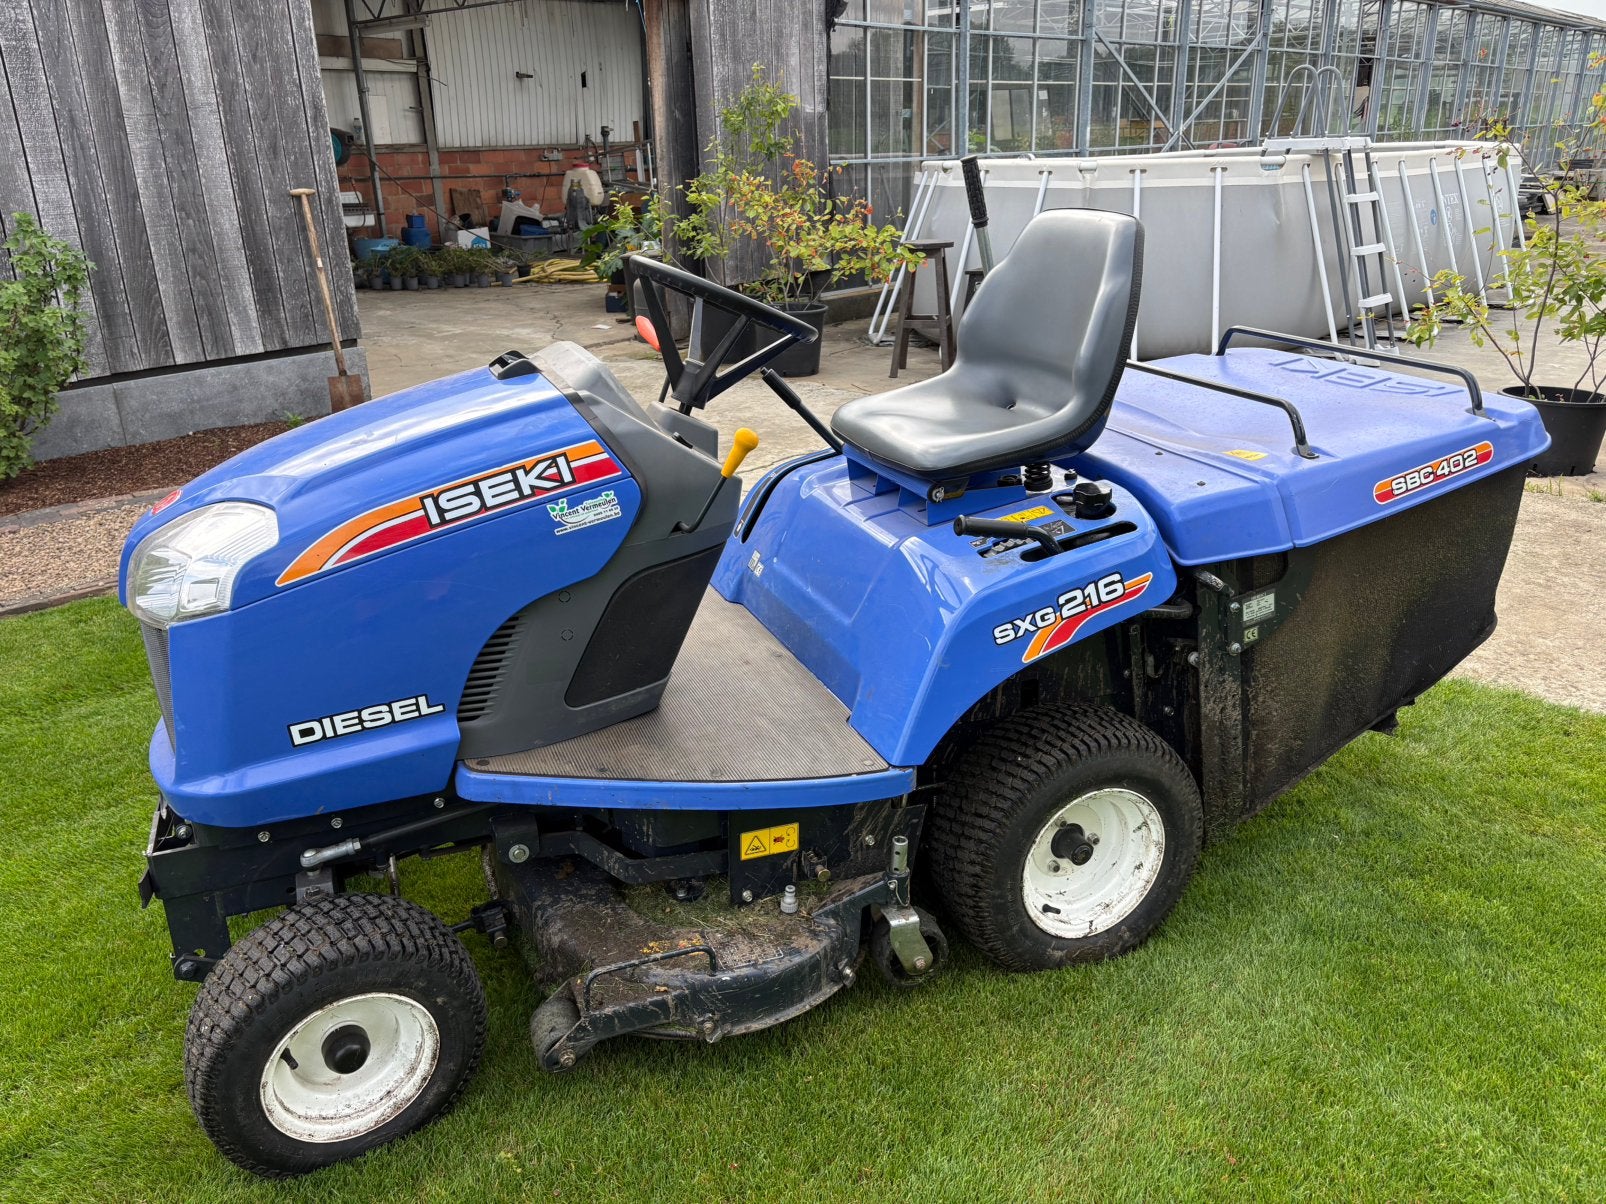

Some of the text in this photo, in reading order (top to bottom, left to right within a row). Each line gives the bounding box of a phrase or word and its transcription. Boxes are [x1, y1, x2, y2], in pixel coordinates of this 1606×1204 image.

[1269, 357, 1465, 398] ISEKI
[421, 453, 575, 527] ISEKI
[1391, 449, 1478, 496] SBC 402
[552, 508, 580, 520] Vincent
[580, 497, 616, 512] Vermeulen
[993, 571, 1125, 646] SXG 216
[288, 694, 445, 747] DIESEL
